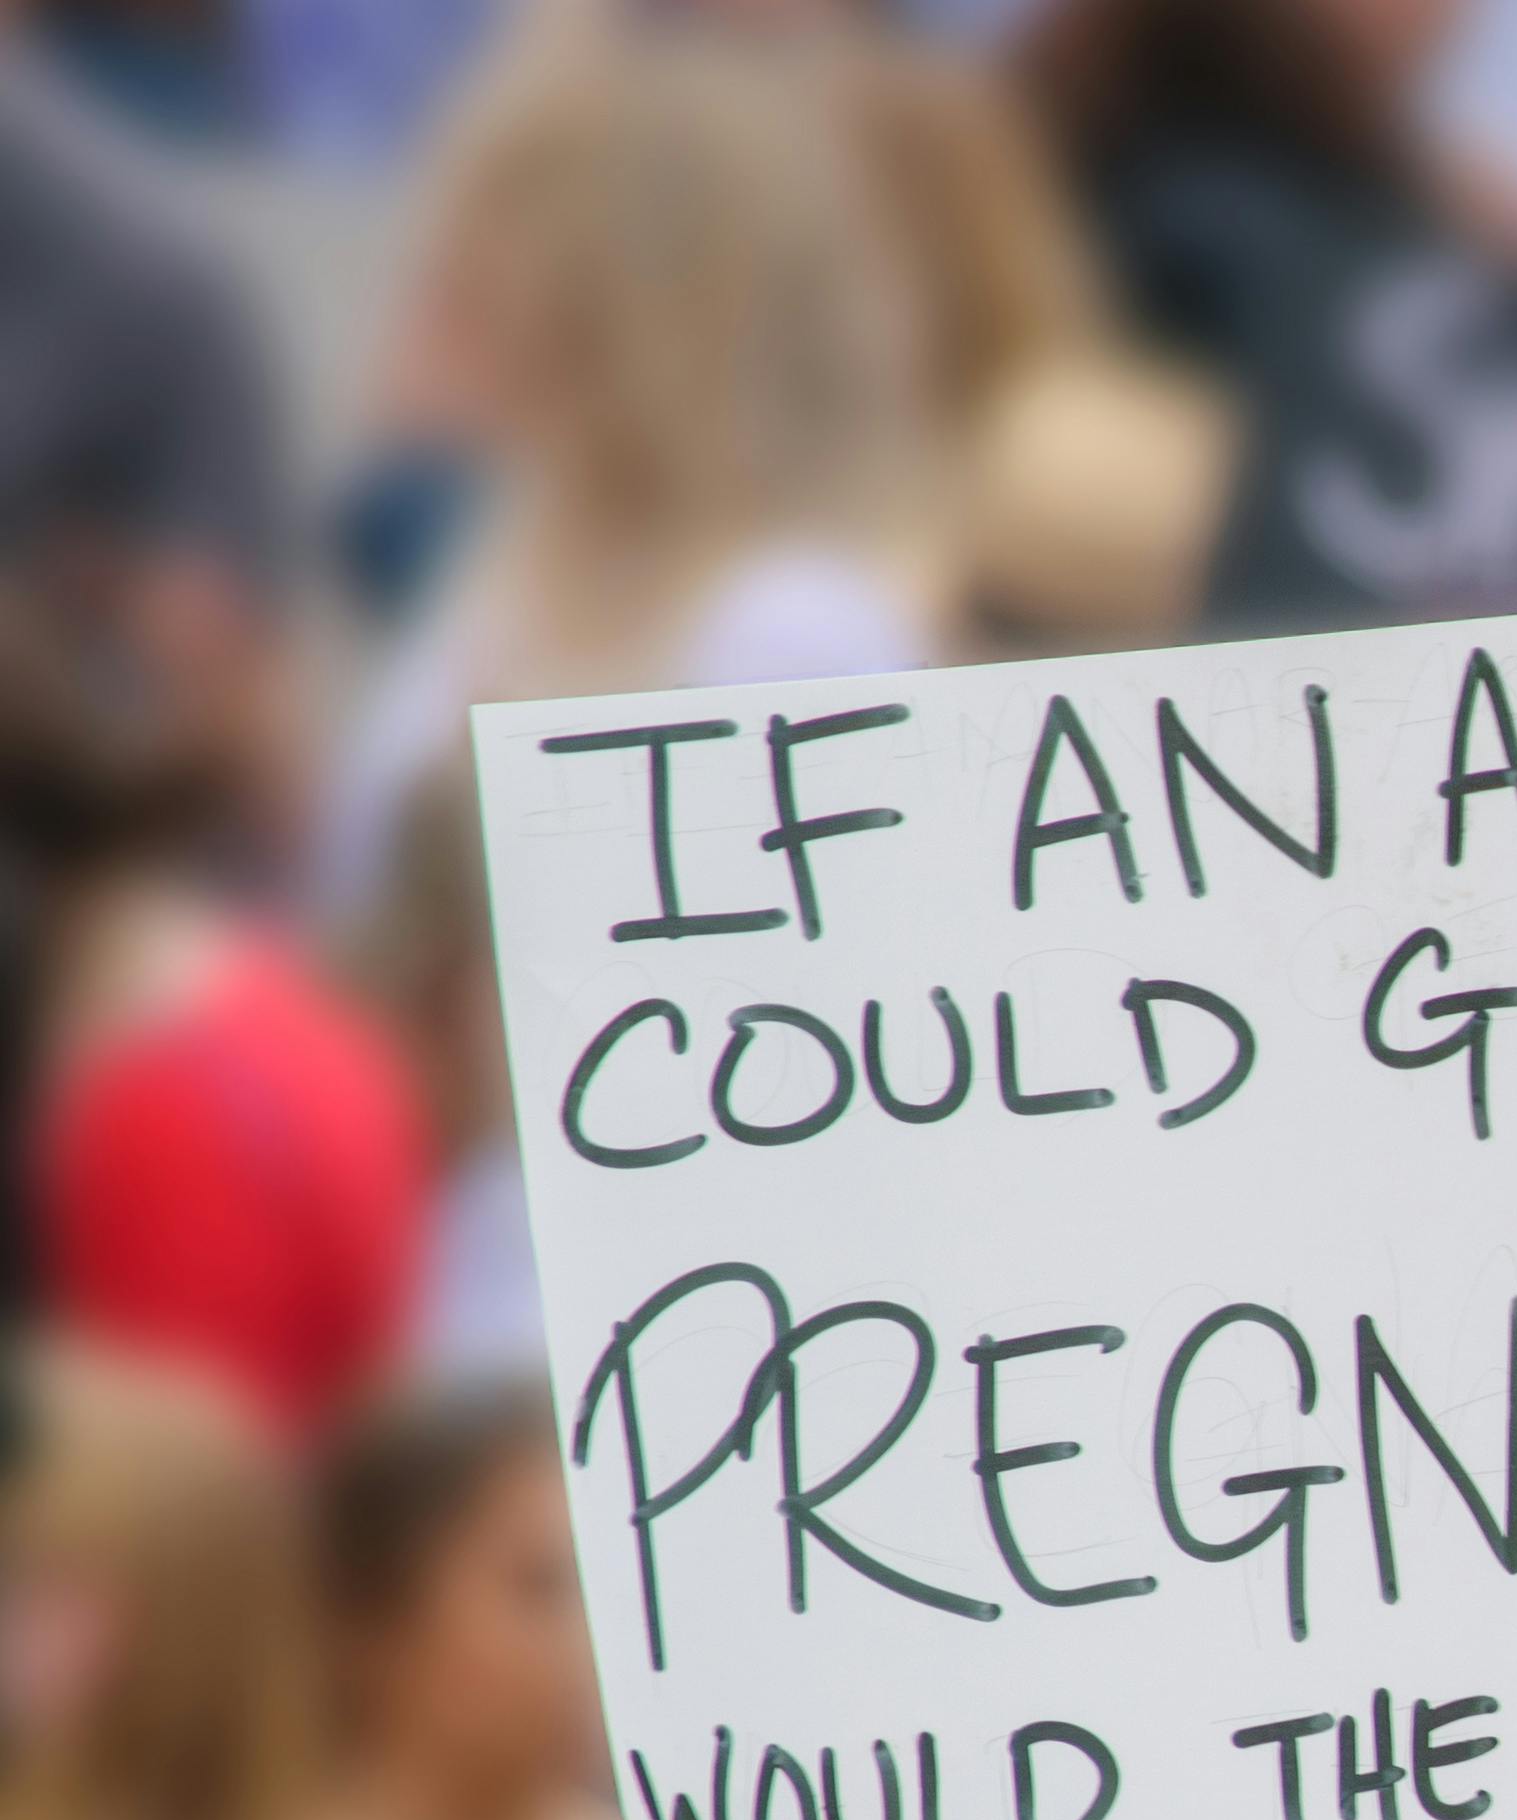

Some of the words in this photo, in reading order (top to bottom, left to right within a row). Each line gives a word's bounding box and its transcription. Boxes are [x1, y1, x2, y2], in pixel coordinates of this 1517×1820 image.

[541, 705, 907, 942] IF
[1014, 685, 1336, 911] AN
[562, 979, 1255, 1168] COULD
